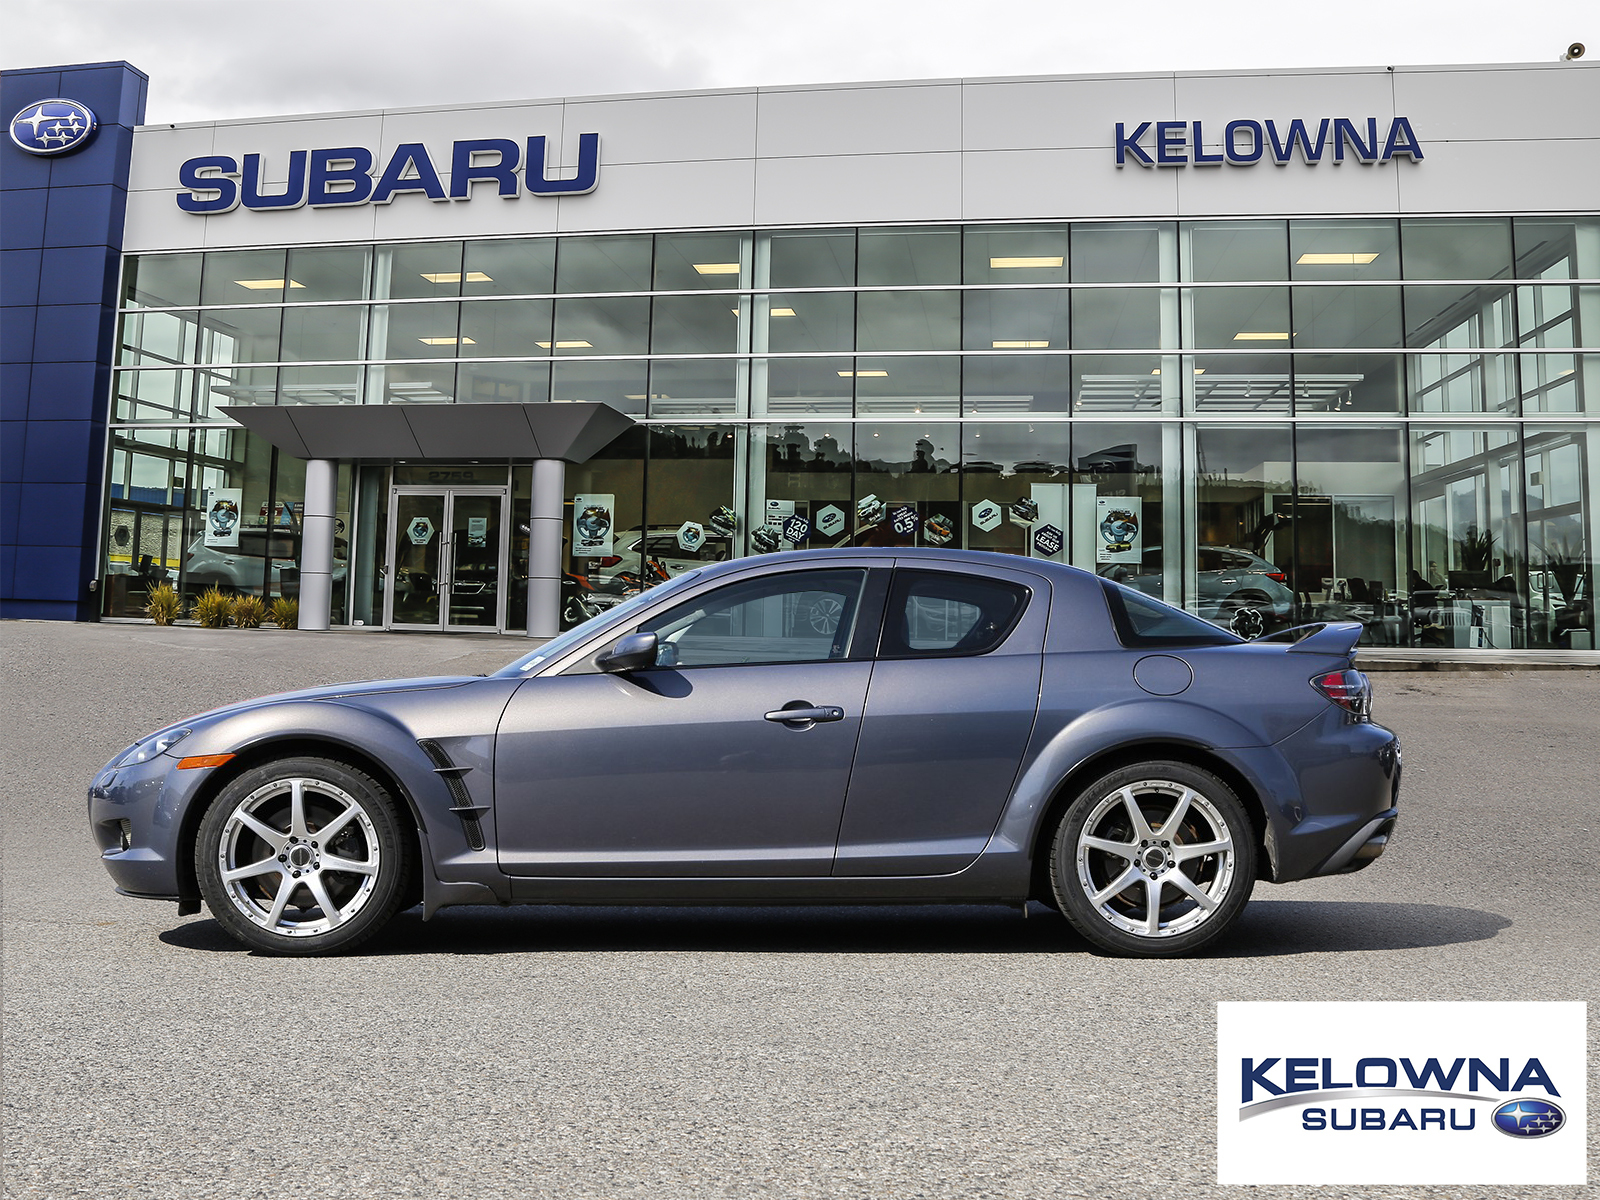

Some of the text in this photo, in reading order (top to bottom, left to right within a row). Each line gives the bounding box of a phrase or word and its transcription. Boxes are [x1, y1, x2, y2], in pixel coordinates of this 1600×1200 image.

[1114, 116, 1425, 168] KELOWNA
[176, 132, 600, 214] SUBARU
[429, 471, 474, 482] 2759
[790, 518, 808, 533] 120
[823, 518, 841, 530] SUBARU
[894, 513, 918, 534] 0.5%
[980, 513, 998, 525] SUBARU
[786, 526, 805, 540] DAY
[1036, 534, 1060, 551] LEASE
